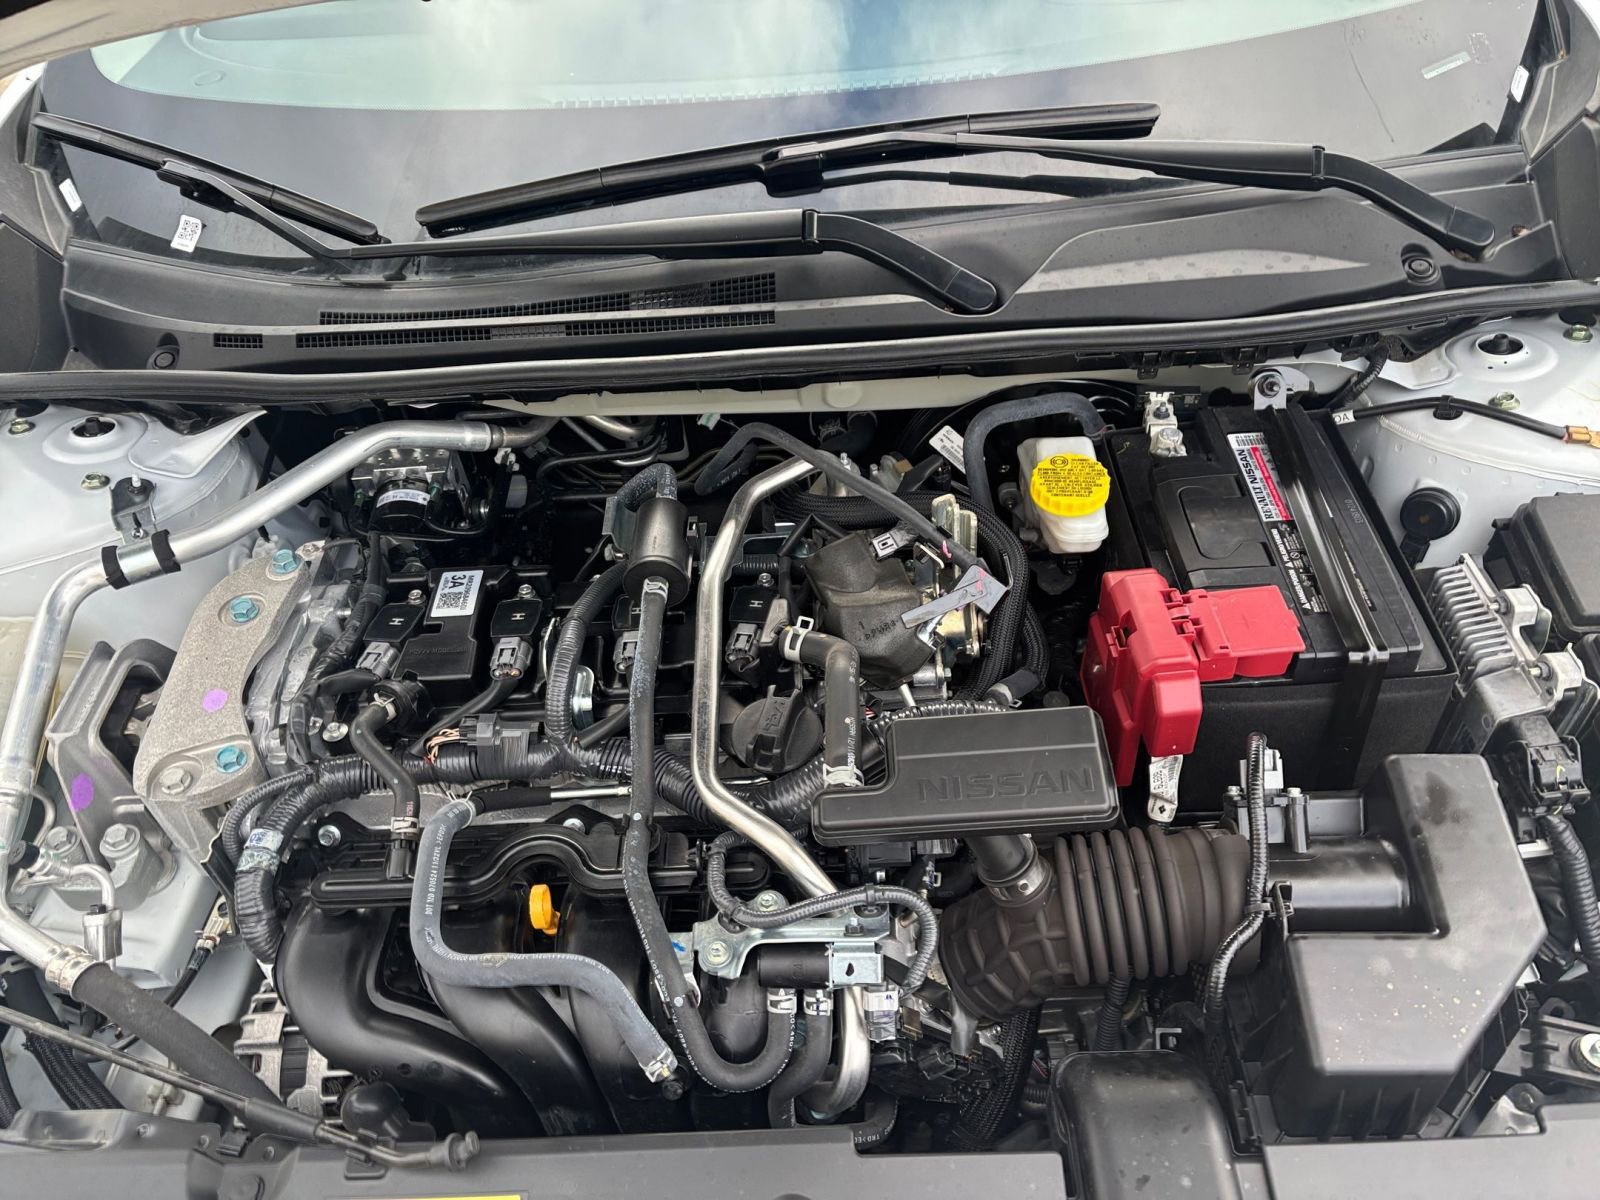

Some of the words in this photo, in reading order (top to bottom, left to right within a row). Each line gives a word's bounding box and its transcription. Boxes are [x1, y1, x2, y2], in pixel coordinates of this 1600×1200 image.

[1236, 449, 1259, 484] NISSAN
[1253, 487, 1274, 519] RENAULT
[449, 574, 467, 589] 3A
[917, 767, 1096, 803] NISSAN
